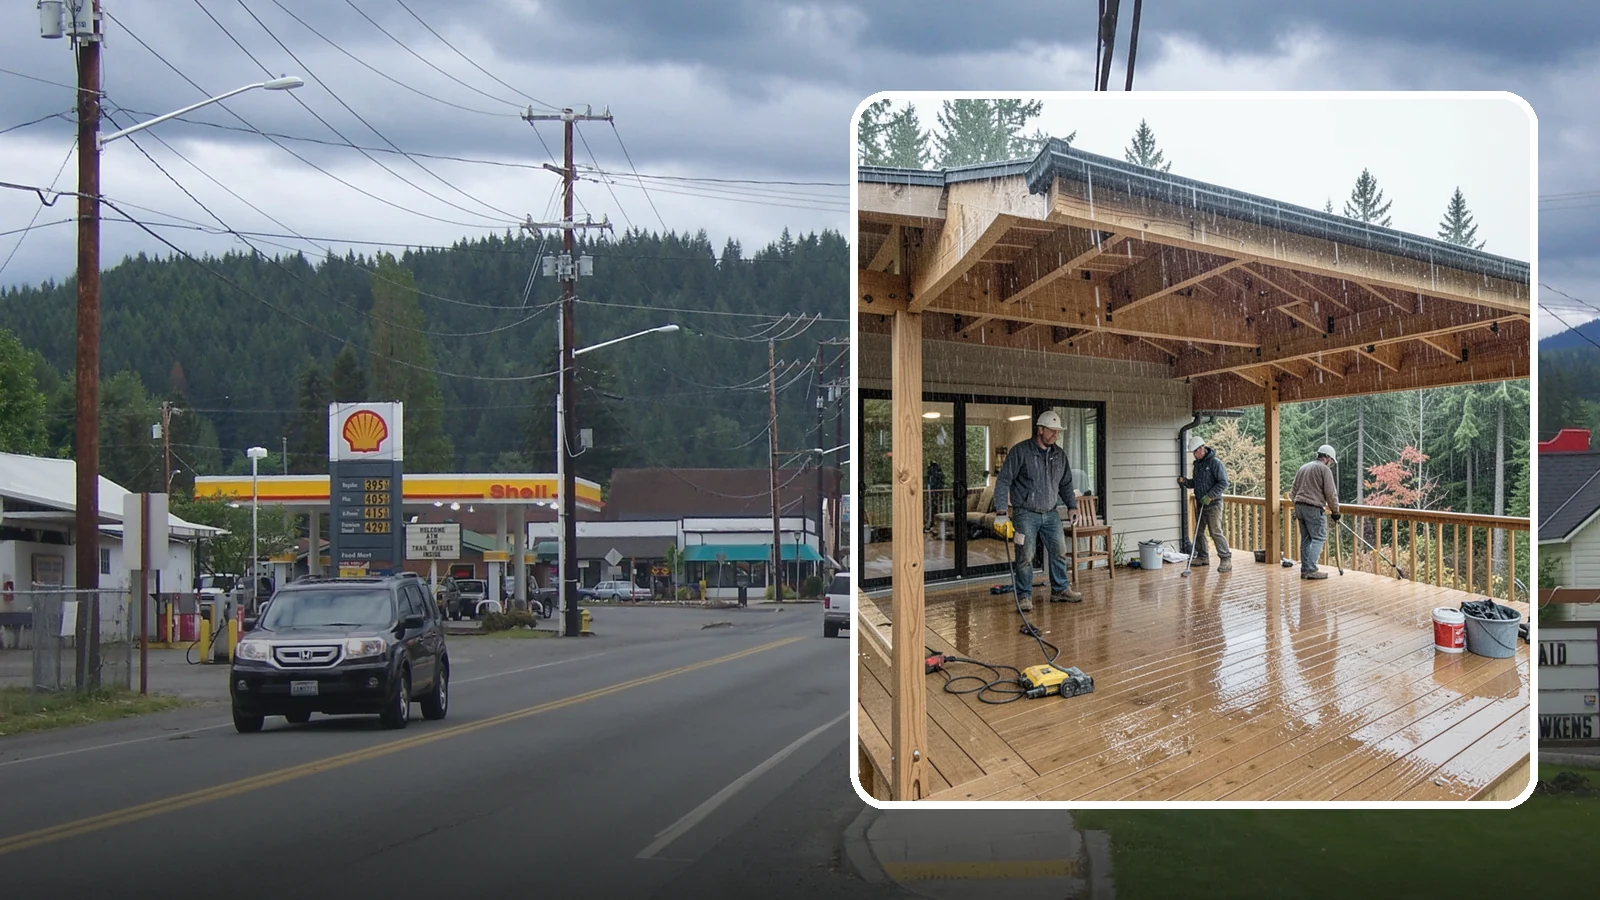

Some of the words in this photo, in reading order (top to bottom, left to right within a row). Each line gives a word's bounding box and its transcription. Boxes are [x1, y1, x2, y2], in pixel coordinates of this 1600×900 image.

[366, 480, 383, 490] 395
[490, 484, 547, 499] Shell
[366, 494, 383, 504] 405
[366, 508, 383, 518] 415
[366, 522, 383, 533] 429
